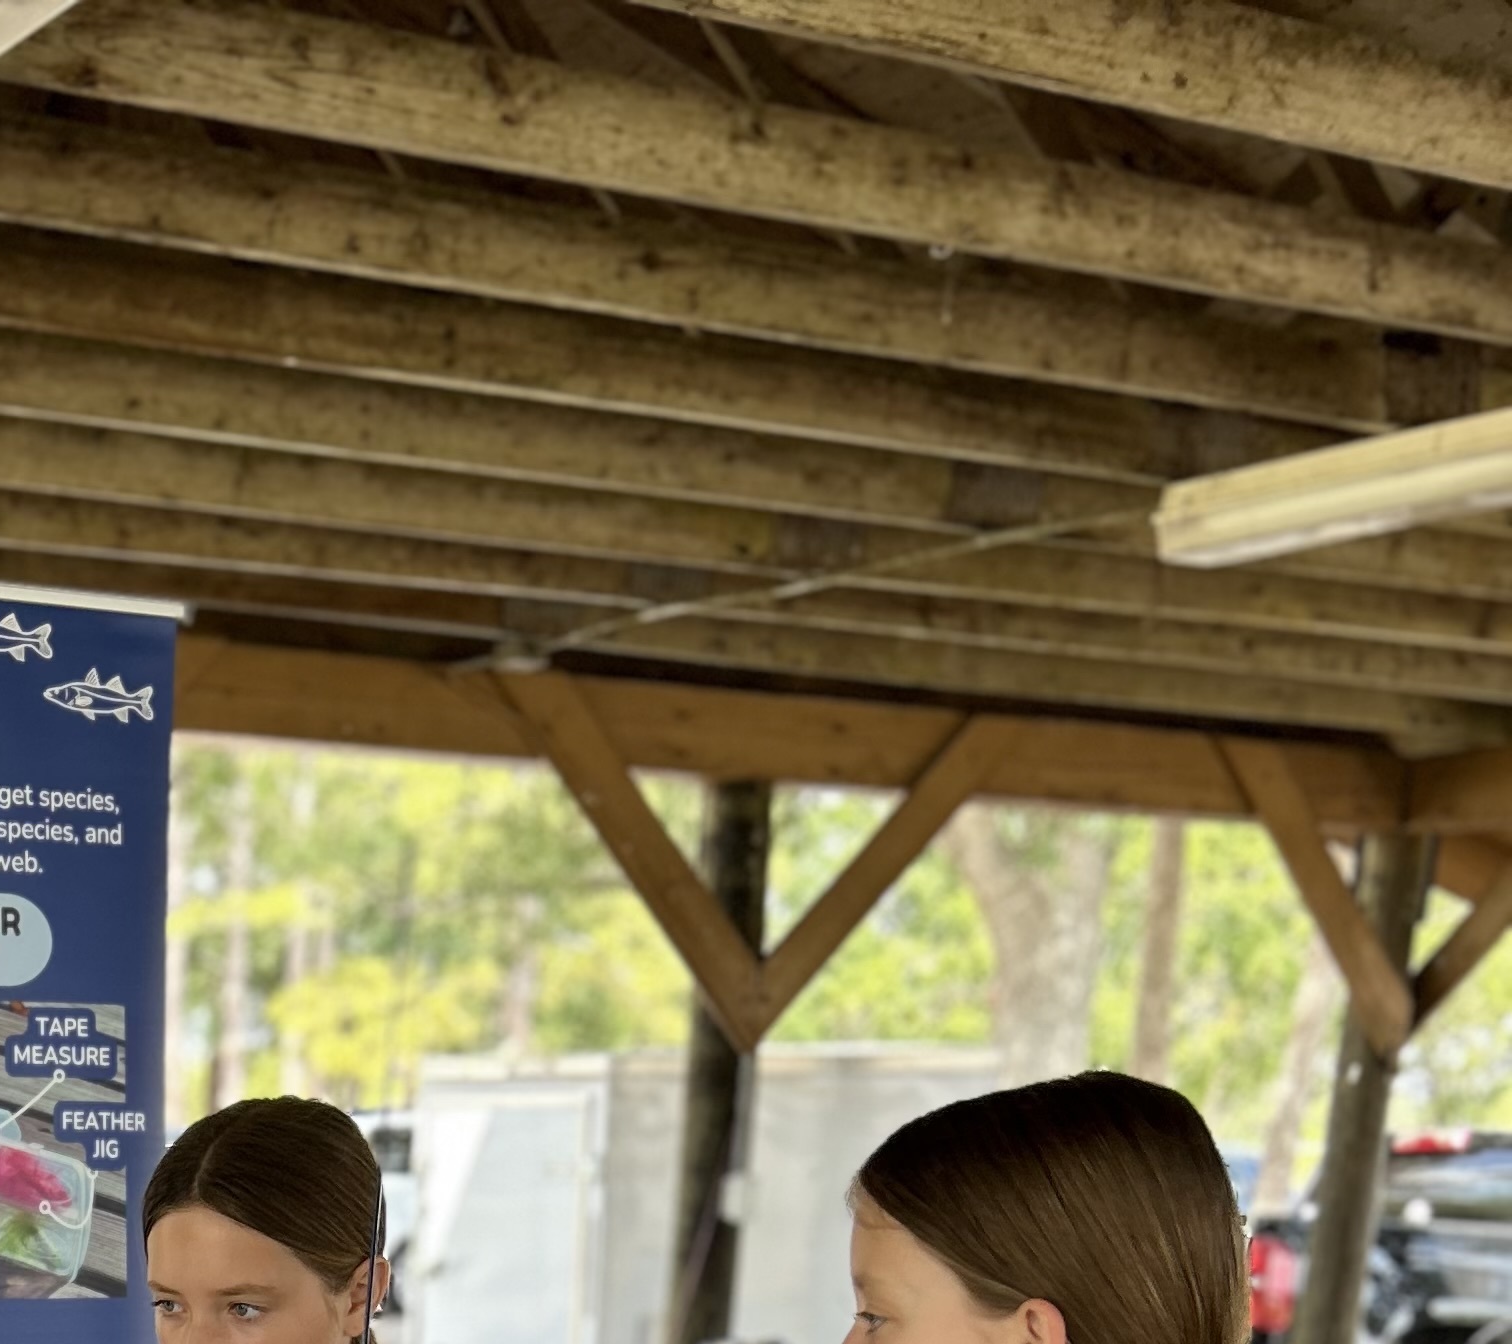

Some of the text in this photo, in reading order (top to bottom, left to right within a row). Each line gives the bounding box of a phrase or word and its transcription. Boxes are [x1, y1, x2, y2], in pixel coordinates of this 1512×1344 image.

[39, 788, 120, 814] species,
[86, 823, 122, 845] and
[36, 1017, 88, 1037] TAPE
[14, 1045, 110, 1067] MEASURE
[62, 1110, 145, 1132] FEATHER
[93, 1139, 119, 1159] JIG
